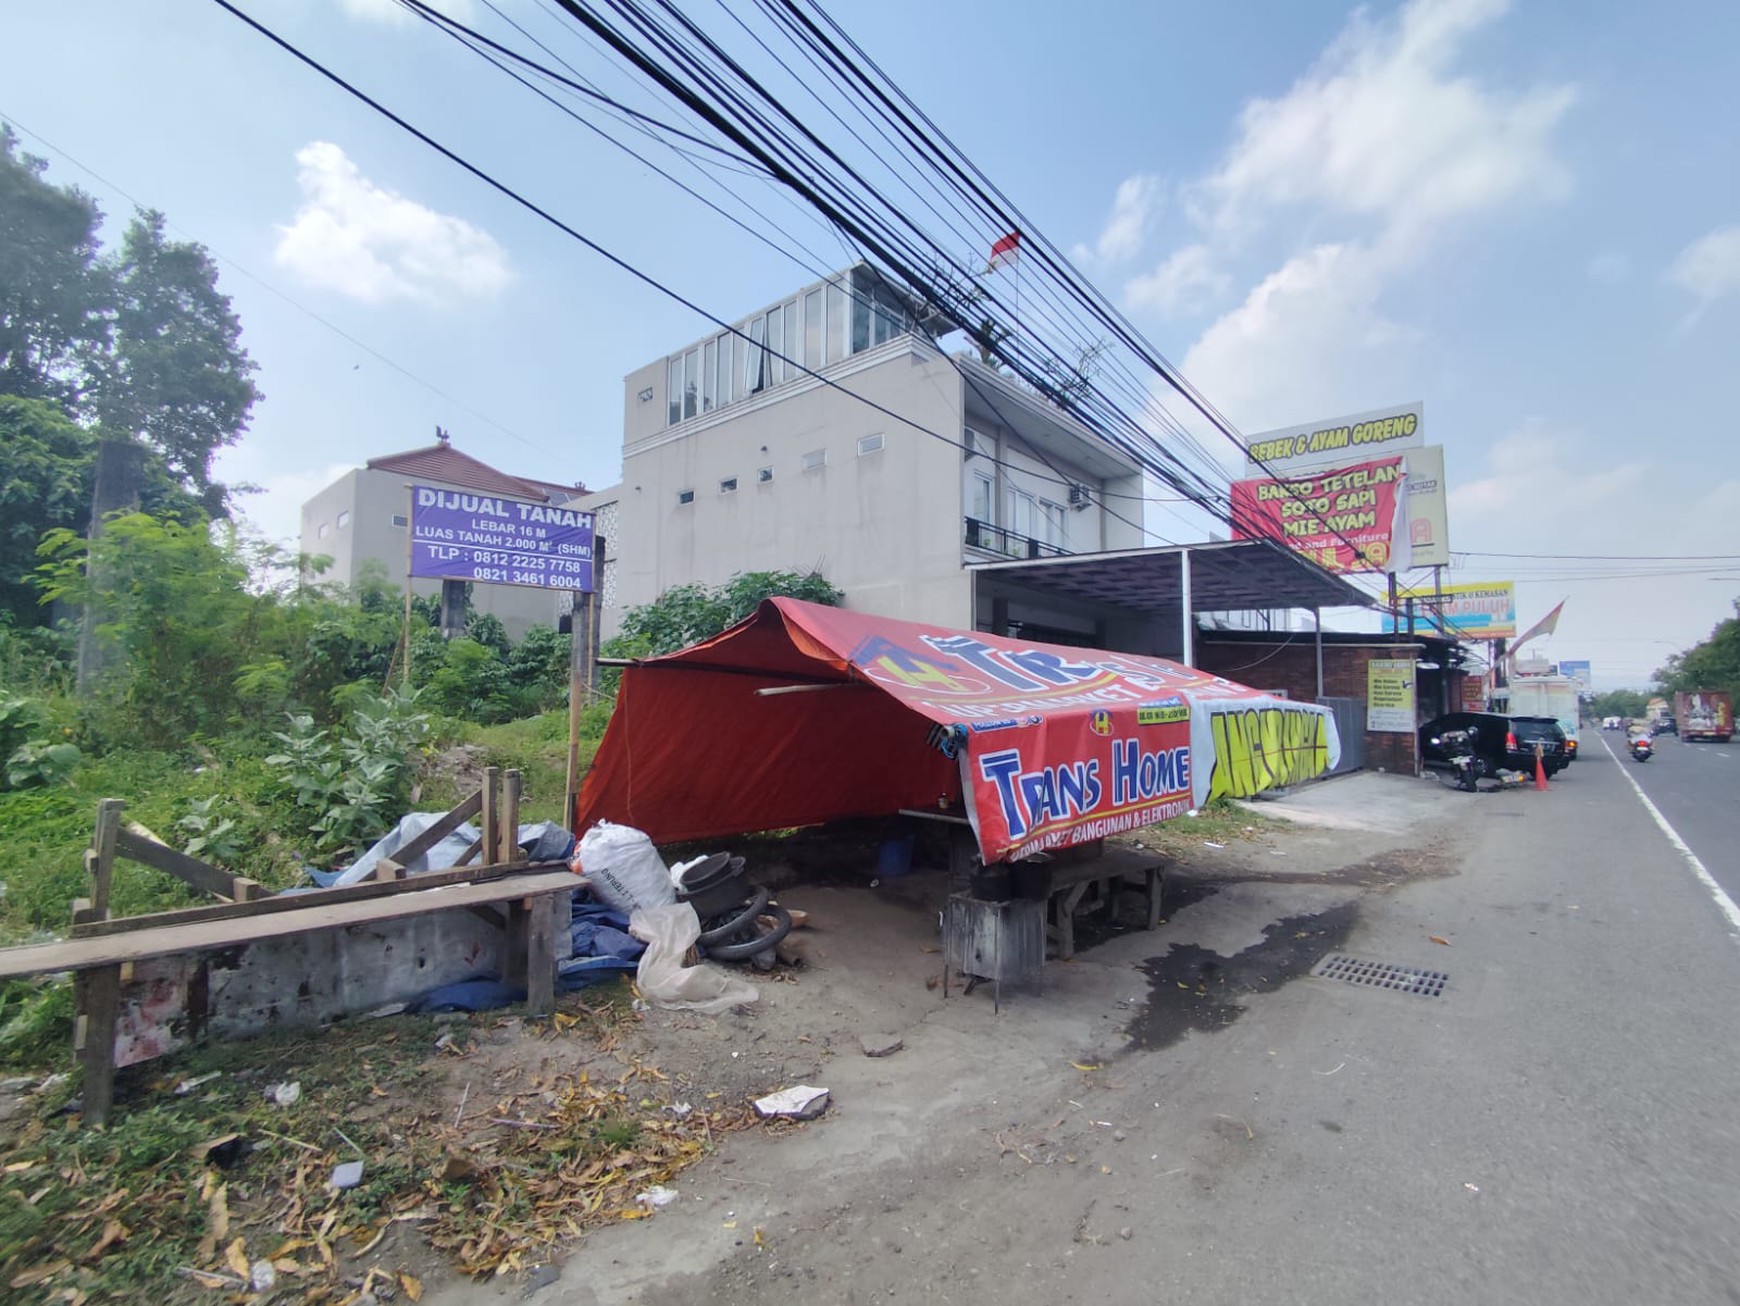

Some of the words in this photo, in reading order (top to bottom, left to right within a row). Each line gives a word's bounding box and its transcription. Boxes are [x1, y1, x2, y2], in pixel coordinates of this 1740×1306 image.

[1295, 436, 1307, 455] &
[1309, 426, 1350, 453] AYAM
[1352, 413, 1417, 445] GORENG
[1257, 481, 1314, 501] BAKSO
[1321, 464, 1401, 492] TETELAN
[418, 489, 509, 517] DIJUAL
[516, 505, 591, 529] TANAH
[1281, 497, 1330, 518] SOTO
[1336, 490, 1377, 511] SAPI
[472, 519, 516, 535] LEBAR
[520, 526, 532, 536] 16
[536, 528, 546, 538] M
[1282, 518, 1320, 537] MIE
[1323, 511, 1375, 533] AYAM
[416, 526, 454, 540] LUAS
[457, 530, 502, 546] TANAH
[505, 538, 536, 550] 2.000
[558, 543, 591, 559] (SHM)
[1330, 532, 1389, 547] Furniture
[428, 545, 460, 561] TLP
[474, 550, 508, 566] 0812
[512, 555, 546, 570] 2225
[550, 559, 581, 573] 7758
[474, 568, 508, 582] 0821
[513, 571, 545, 585] 3461
[549, 574, 581, 588] 6004
[977, 747, 1102, 841] TRANS
[1110, 736, 1192, 808] HOME
[1071, 813, 1132, 843] BANGUNAN
[1133, 811, 1141, 827] &
